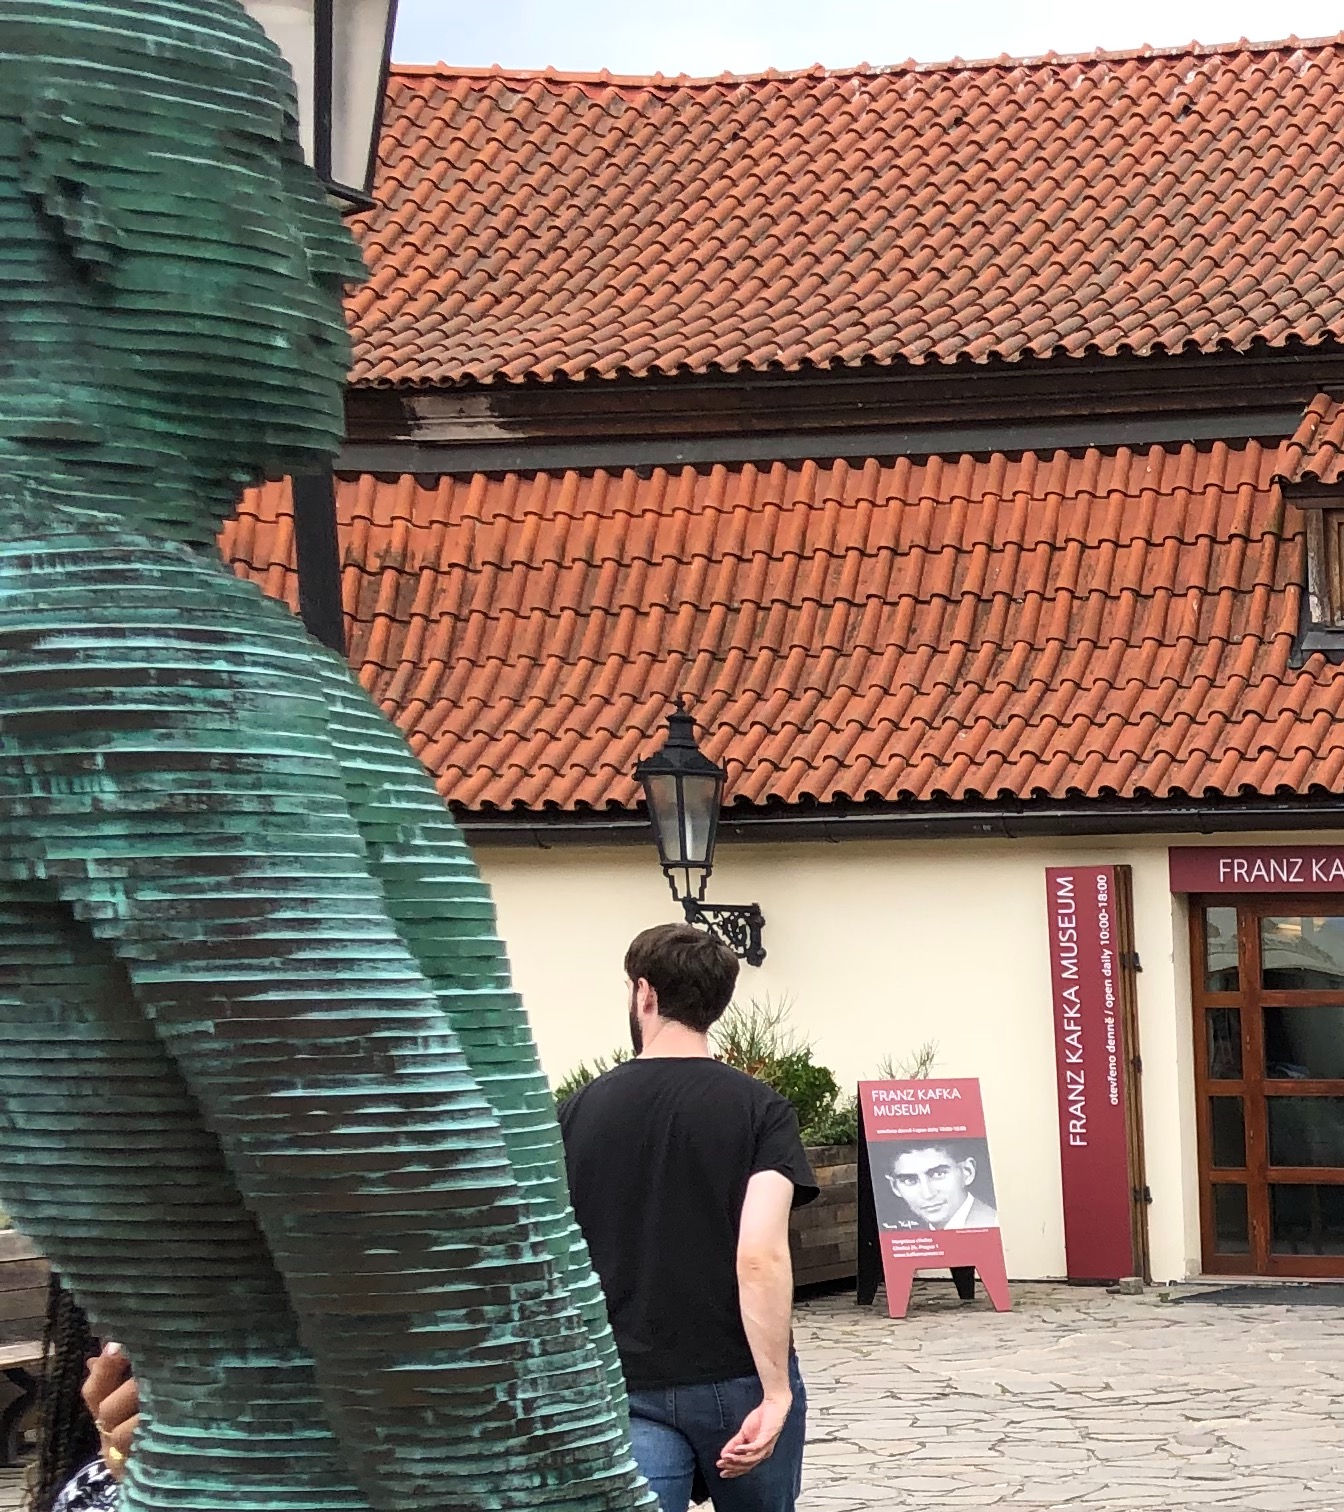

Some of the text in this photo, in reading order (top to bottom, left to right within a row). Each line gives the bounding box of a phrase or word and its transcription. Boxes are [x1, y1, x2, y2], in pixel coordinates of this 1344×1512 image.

[1218, 858, 1304, 882] FRANZ
[1096, 874, 1110, 946] 10:00-18:00
[1100, 949, 1114, 977] daily
[1104, 979, 1116, 1009] open
[1056, 876, 1088, 1147] FRANZ KAFKA MUSEUM
[871, 1087, 962, 1103] FRANZ KAFKA
[1106, 1055, 1119, 1106] otevřeno
[873, 1103, 931, 1117] MUSEUM
